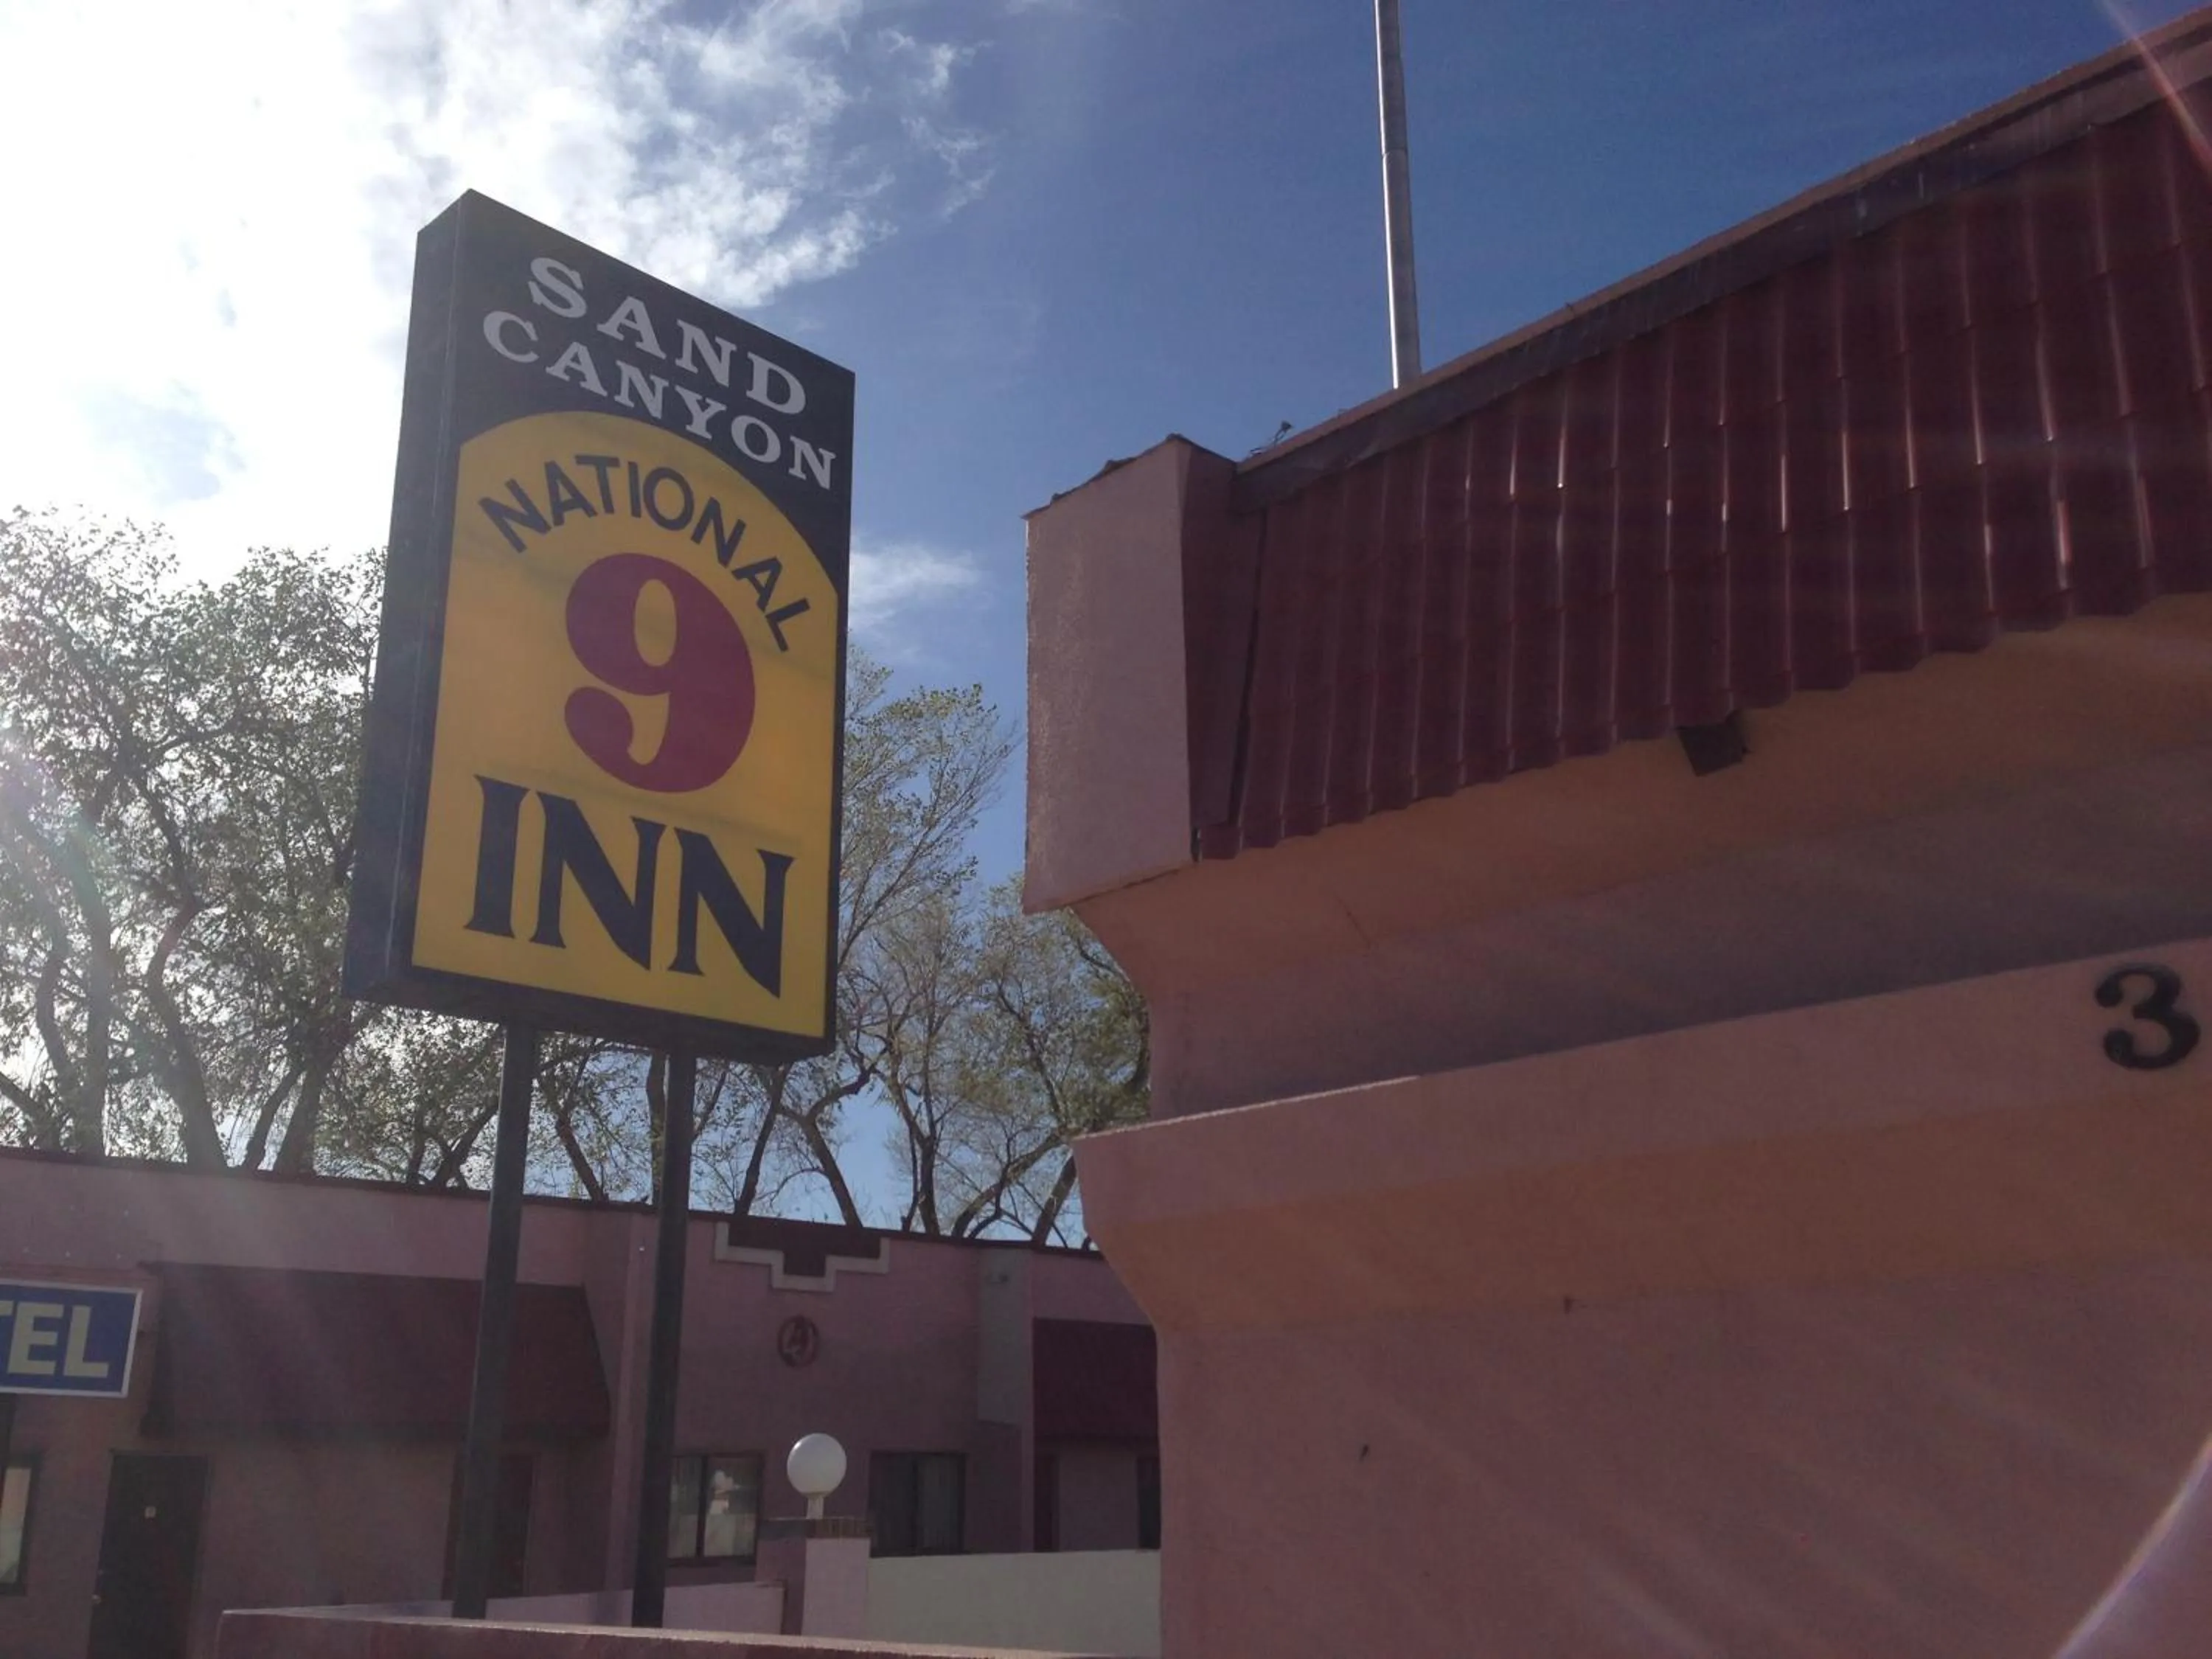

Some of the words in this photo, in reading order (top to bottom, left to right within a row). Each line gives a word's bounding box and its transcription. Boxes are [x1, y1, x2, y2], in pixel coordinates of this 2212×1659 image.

[483, 310, 836, 490] CANYON
[527, 257, 806, 414] SAND
[479, 454, 810, 653] NATIONAL
[565, 552, 756, 793] 9
[463, 774, 796, 999] INN
[2095, 963, 2201, 1070] 3
[0, 1300, 110, 1378] EL
